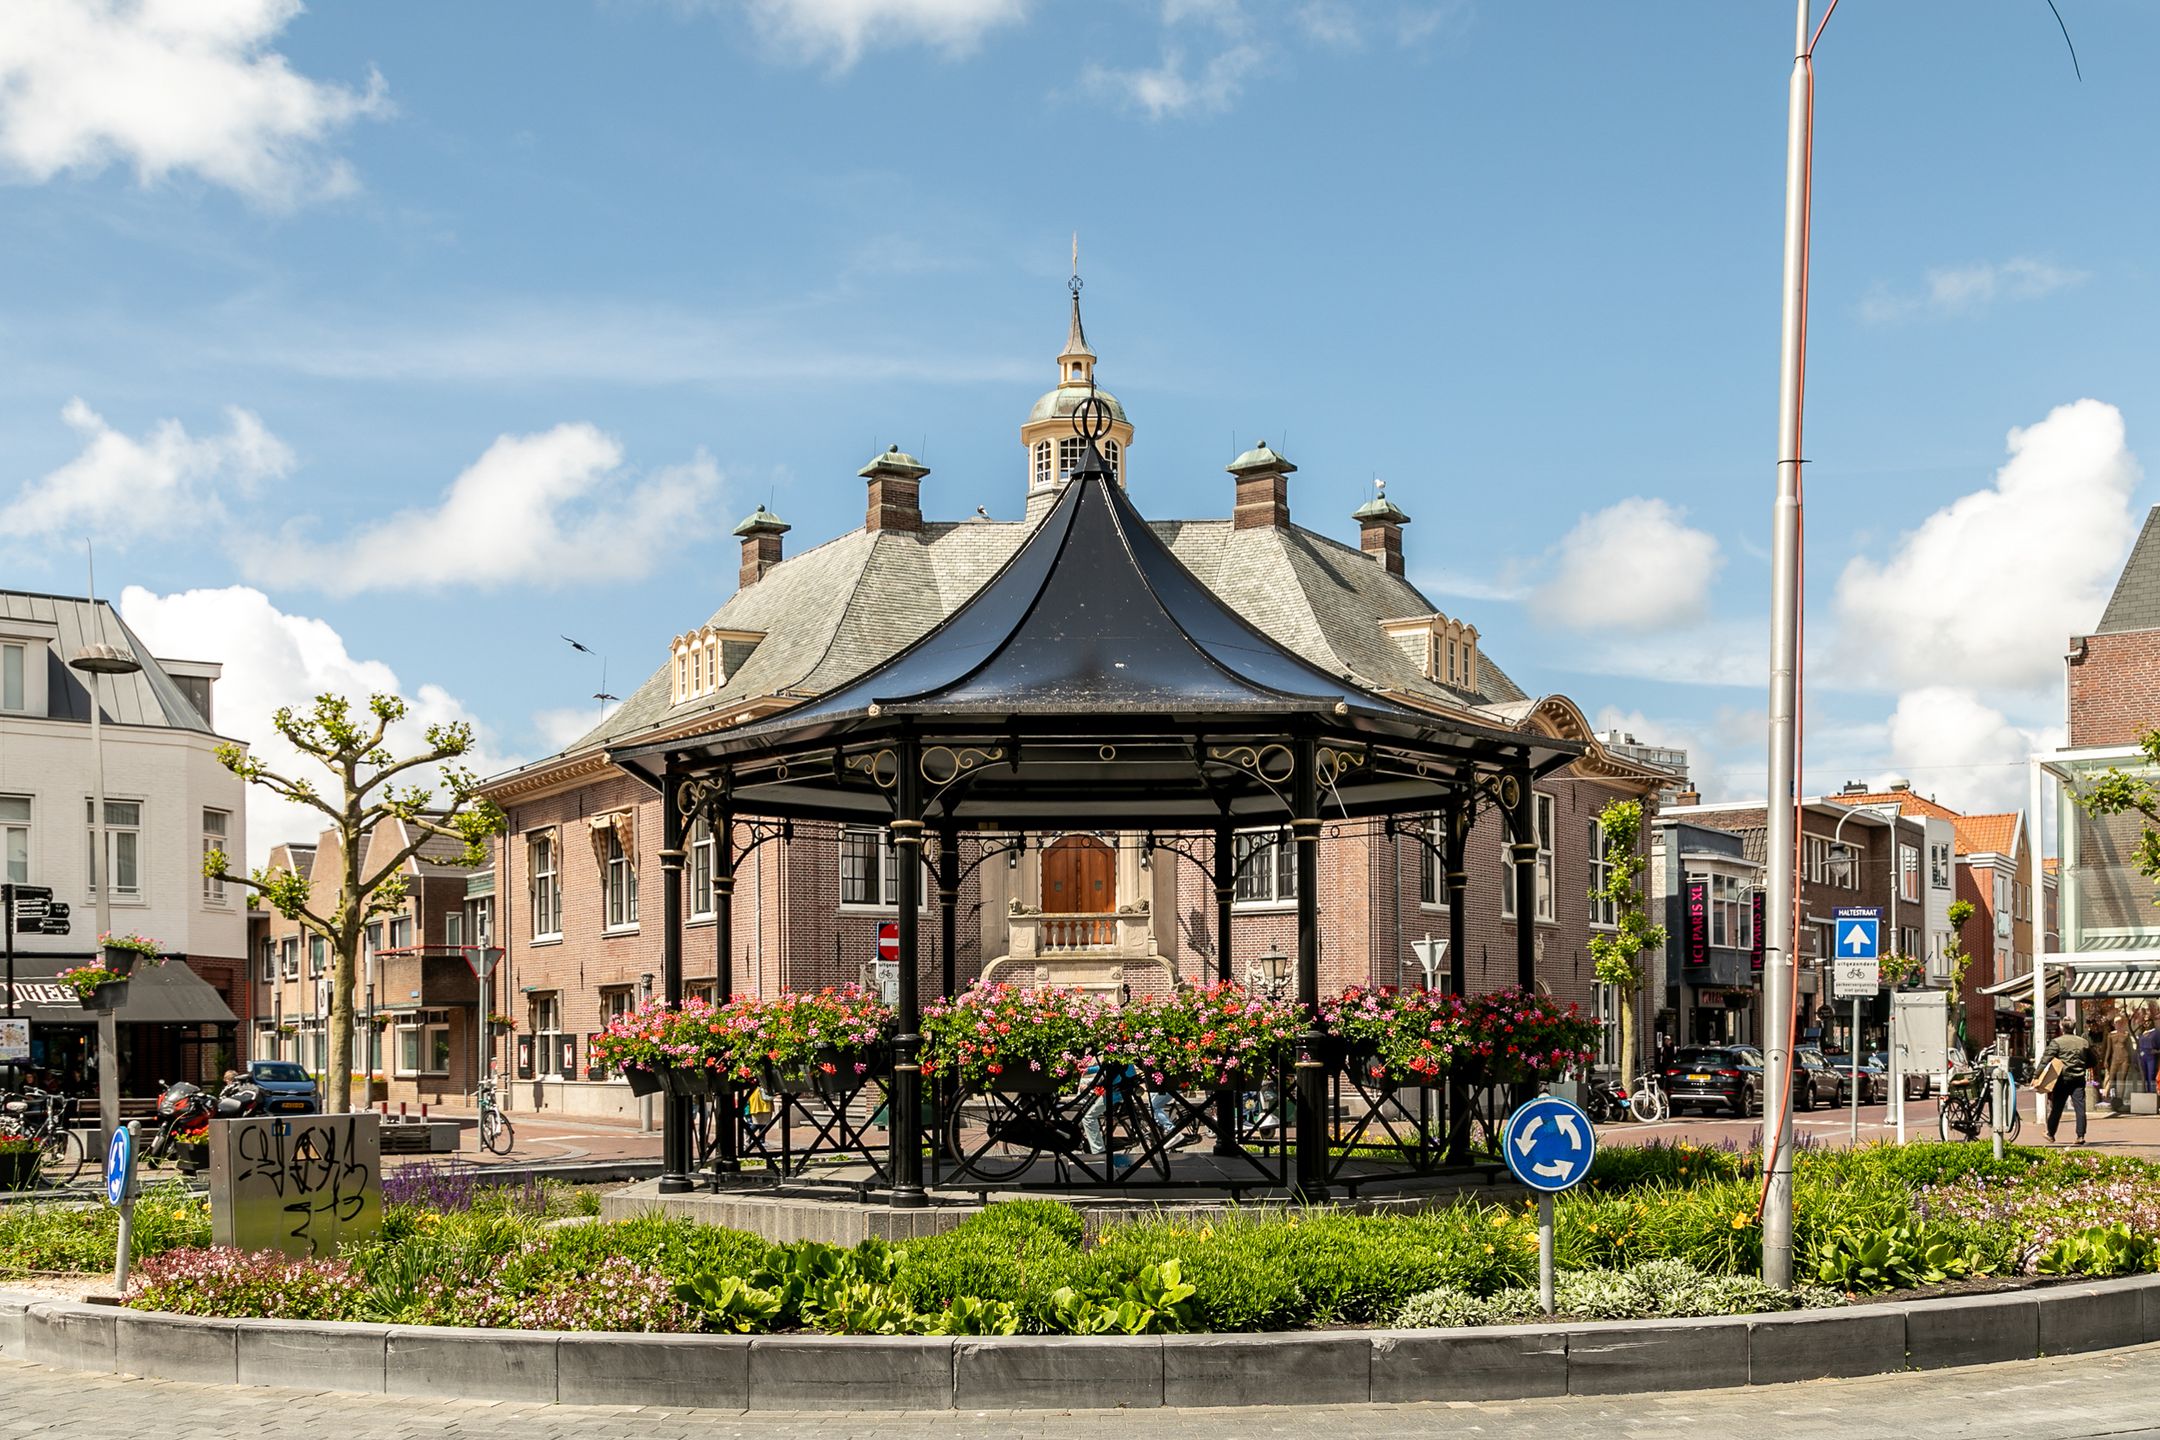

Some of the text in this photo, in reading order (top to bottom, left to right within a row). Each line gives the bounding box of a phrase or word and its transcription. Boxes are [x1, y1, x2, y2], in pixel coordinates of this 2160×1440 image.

[1691, 885, 1704, 963] ICI PARIS XL
[1752, 913, 1762, 947] PARIS
[1752, 951, 1762, 968] ICI
